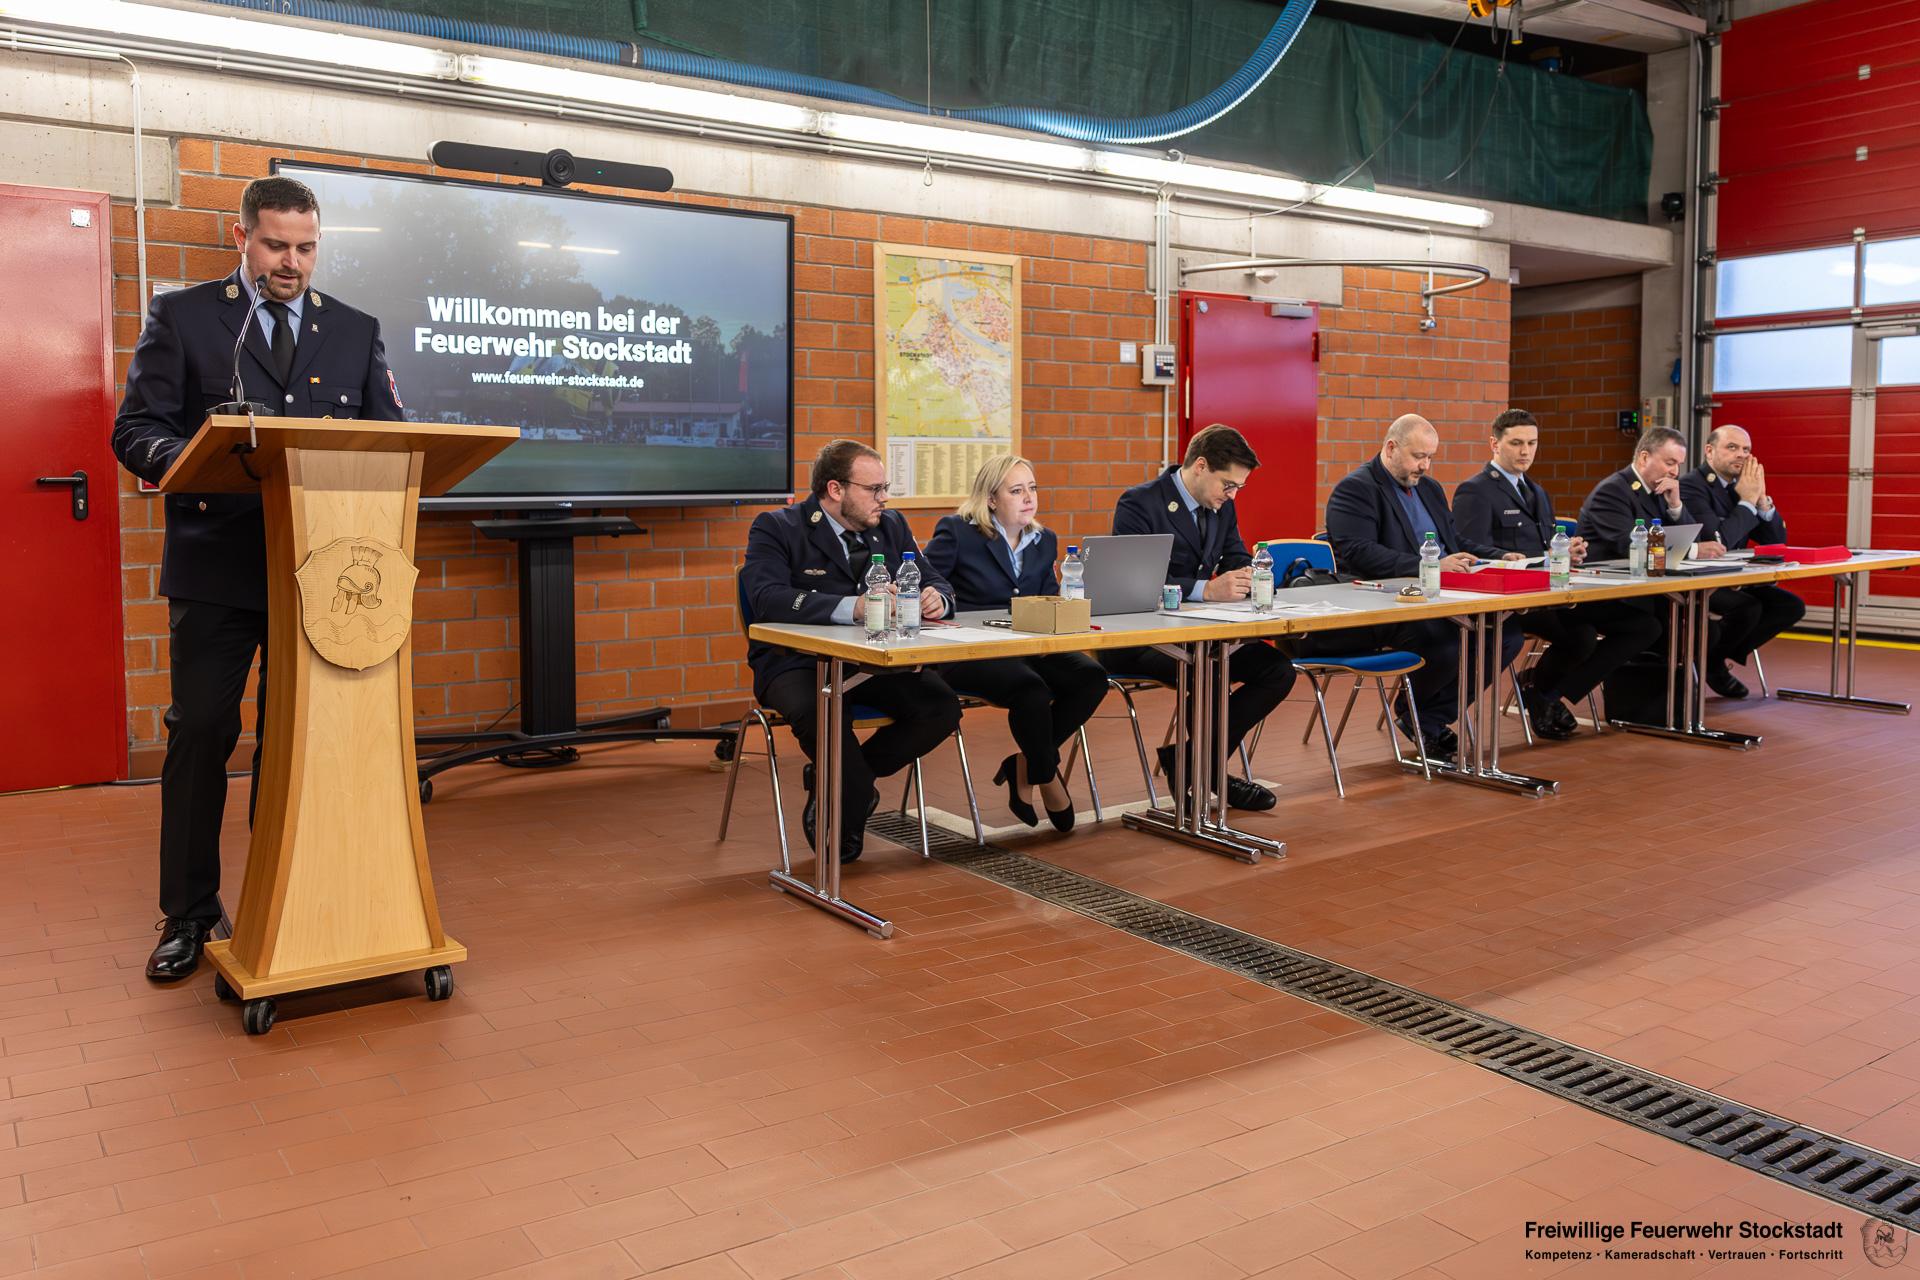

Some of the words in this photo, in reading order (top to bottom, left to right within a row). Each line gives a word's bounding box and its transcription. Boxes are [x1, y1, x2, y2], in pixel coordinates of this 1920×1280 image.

[427, 295, 592, 330] Willkommen
[597, 306, 635, 333] bei
[640, 309, 681, 336] der
[414, 326, 557, 358] Feuerwehr
[561, 334, 693, 365] Stockstadt
[471, 370, 645, 389] www.feuerwehr-stockstadt.de
